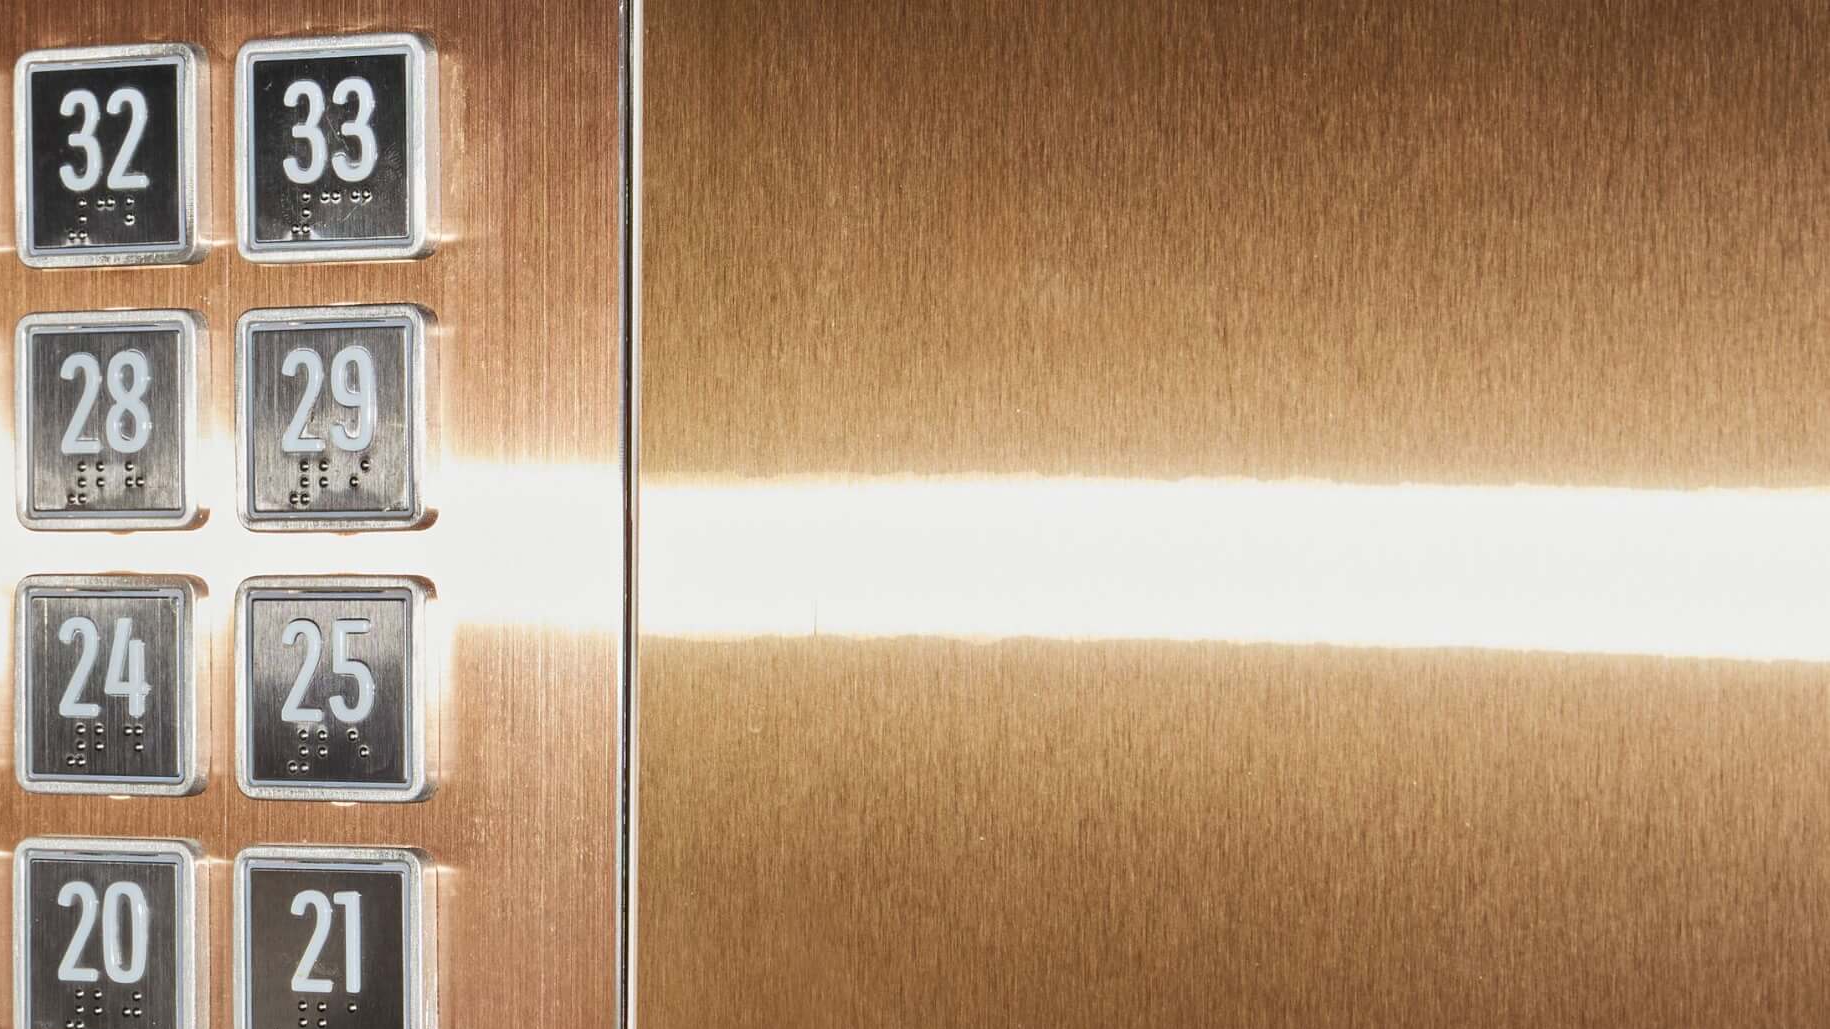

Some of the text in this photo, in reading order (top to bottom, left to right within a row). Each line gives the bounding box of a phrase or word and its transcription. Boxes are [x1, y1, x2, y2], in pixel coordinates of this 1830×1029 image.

[59, 89, 150, 190] 32
[282, 76, 378, 183] 33
[60, 350, 151, 452] 28
[281, 346, 376, 452] 29
[58, 617, 150, 717] 24
[281, 618, 373, 723] 25
[57, 881, 147, 983] 20
[290, 890, 361, 994] 21
